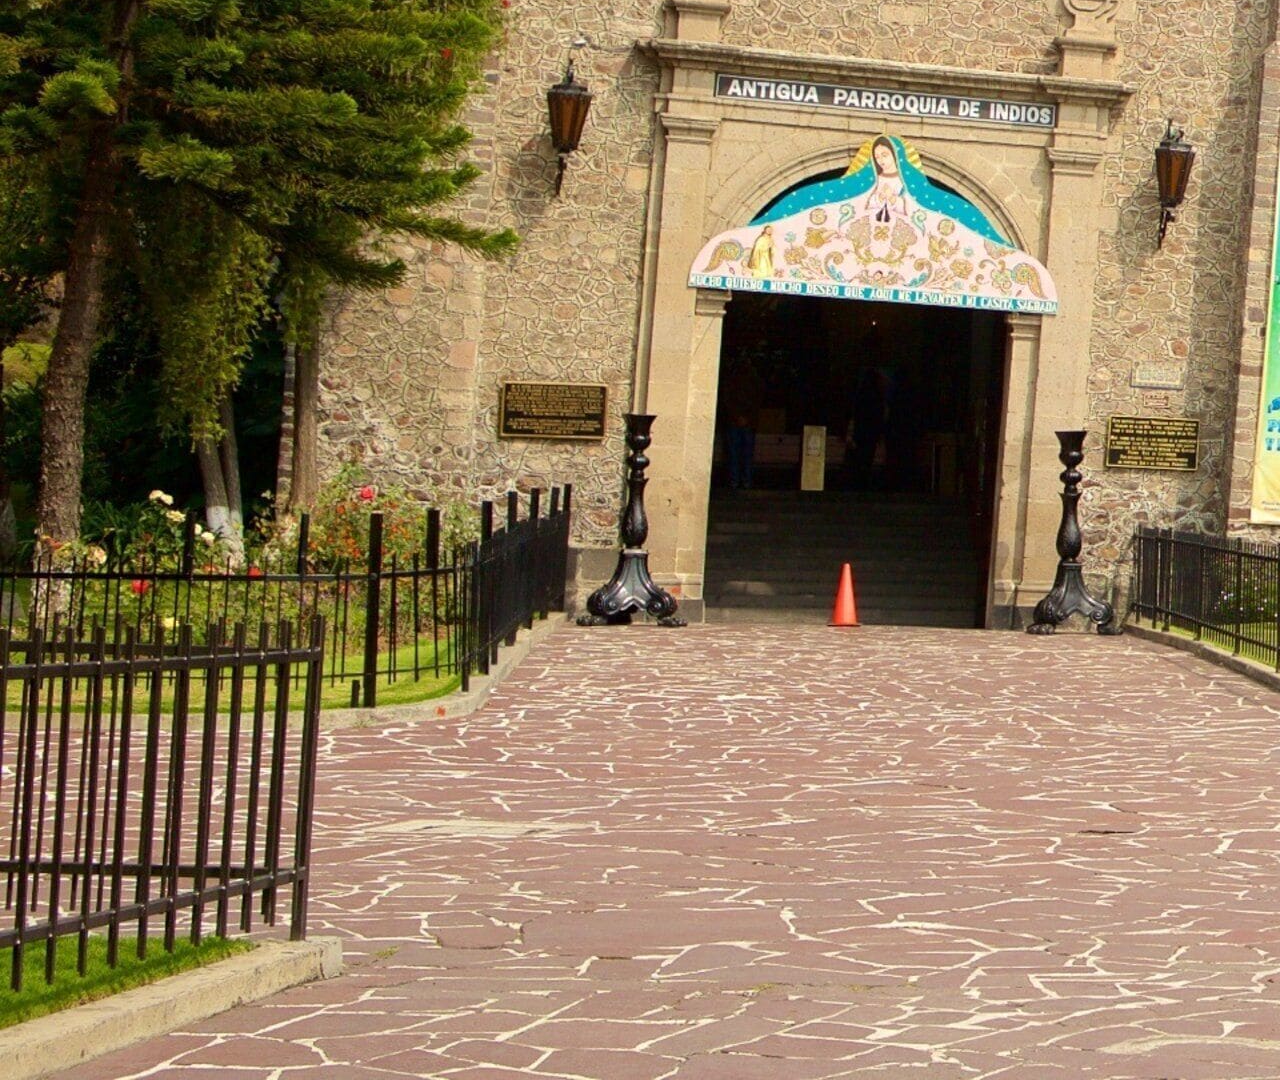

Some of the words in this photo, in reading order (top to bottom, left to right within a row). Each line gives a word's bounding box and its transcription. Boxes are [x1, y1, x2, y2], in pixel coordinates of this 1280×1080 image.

[727, 79, 819, 103] ANTIGUA
[833, 89, 949, 115] PARROQUIA
[958, 100, 981, 118] DE
[989, 103, 1051, 124] INDIOS
[770, 280, 801, 293] MUCHO
[806, 282, 839, 296] DESEO
[844, 286, 864, 298] QUE
[899, 289, 911, 300] ME
[981, 297, 1015, 310] CASITA
[1016, 300, 1058, 313] SAGRADA
[1265, 438, 1274, 451] Y
